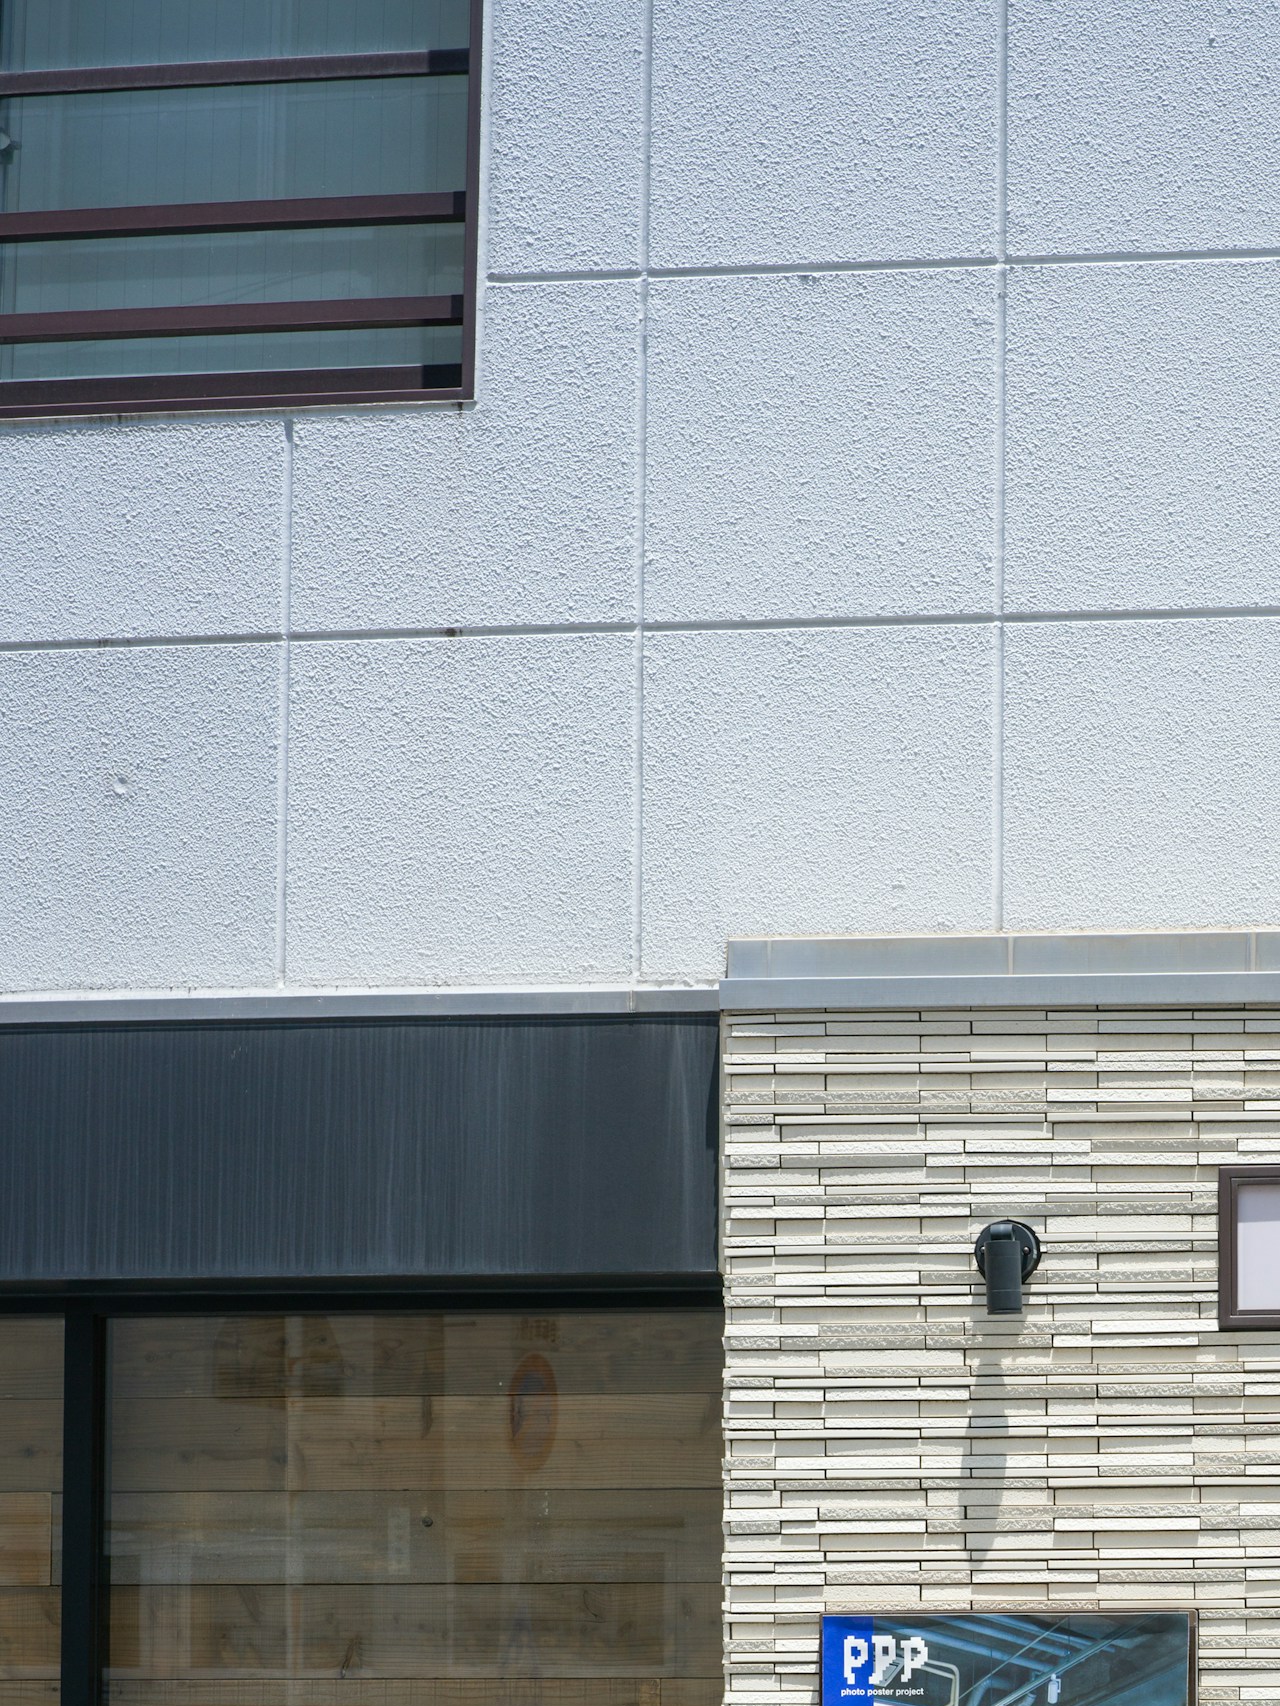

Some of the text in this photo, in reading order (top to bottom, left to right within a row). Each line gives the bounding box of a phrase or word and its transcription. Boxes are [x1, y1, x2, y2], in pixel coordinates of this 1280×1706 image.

[843, 1635, 928, 1684] PPP
[841, 1688, 924, 1697] photo poster project
